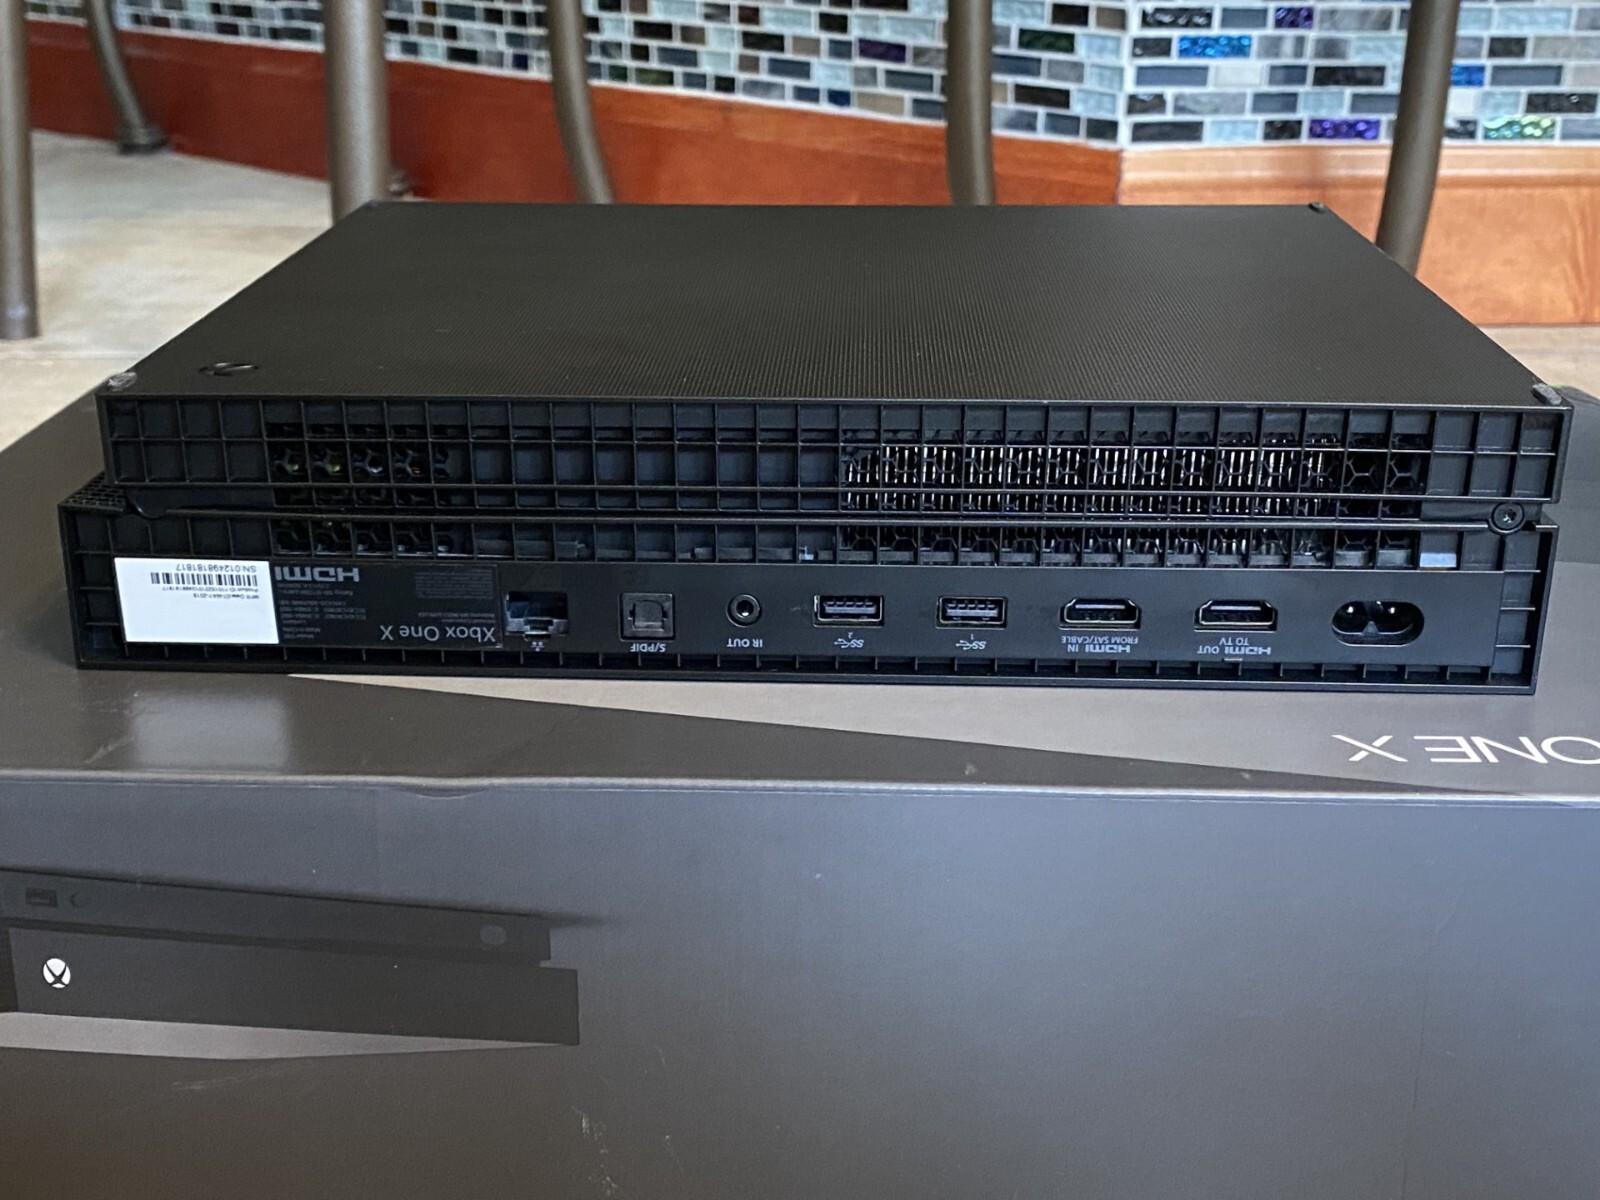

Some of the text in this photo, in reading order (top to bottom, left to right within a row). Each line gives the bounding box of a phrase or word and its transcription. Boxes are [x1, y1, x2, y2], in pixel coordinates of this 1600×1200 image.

[176, 563, 257, 573] SN:012498181817
[274, 566, 360, 582] HDMI
[379, 624, 496, 642] Xbox One X
[726, 638, 763, 648] IR OUT
[1061, 636, 1139, 644] FROM SAT/CABLE
[1219, 637, 1250, 646] TO TV
[630, 643, 666, 652] S/PDIF
[1067, 644, 1131, 653] HDMI IN
[1197, 645, 1272, 656] HDMI OUT
[1331, 734, 1600, 765] ONE X
